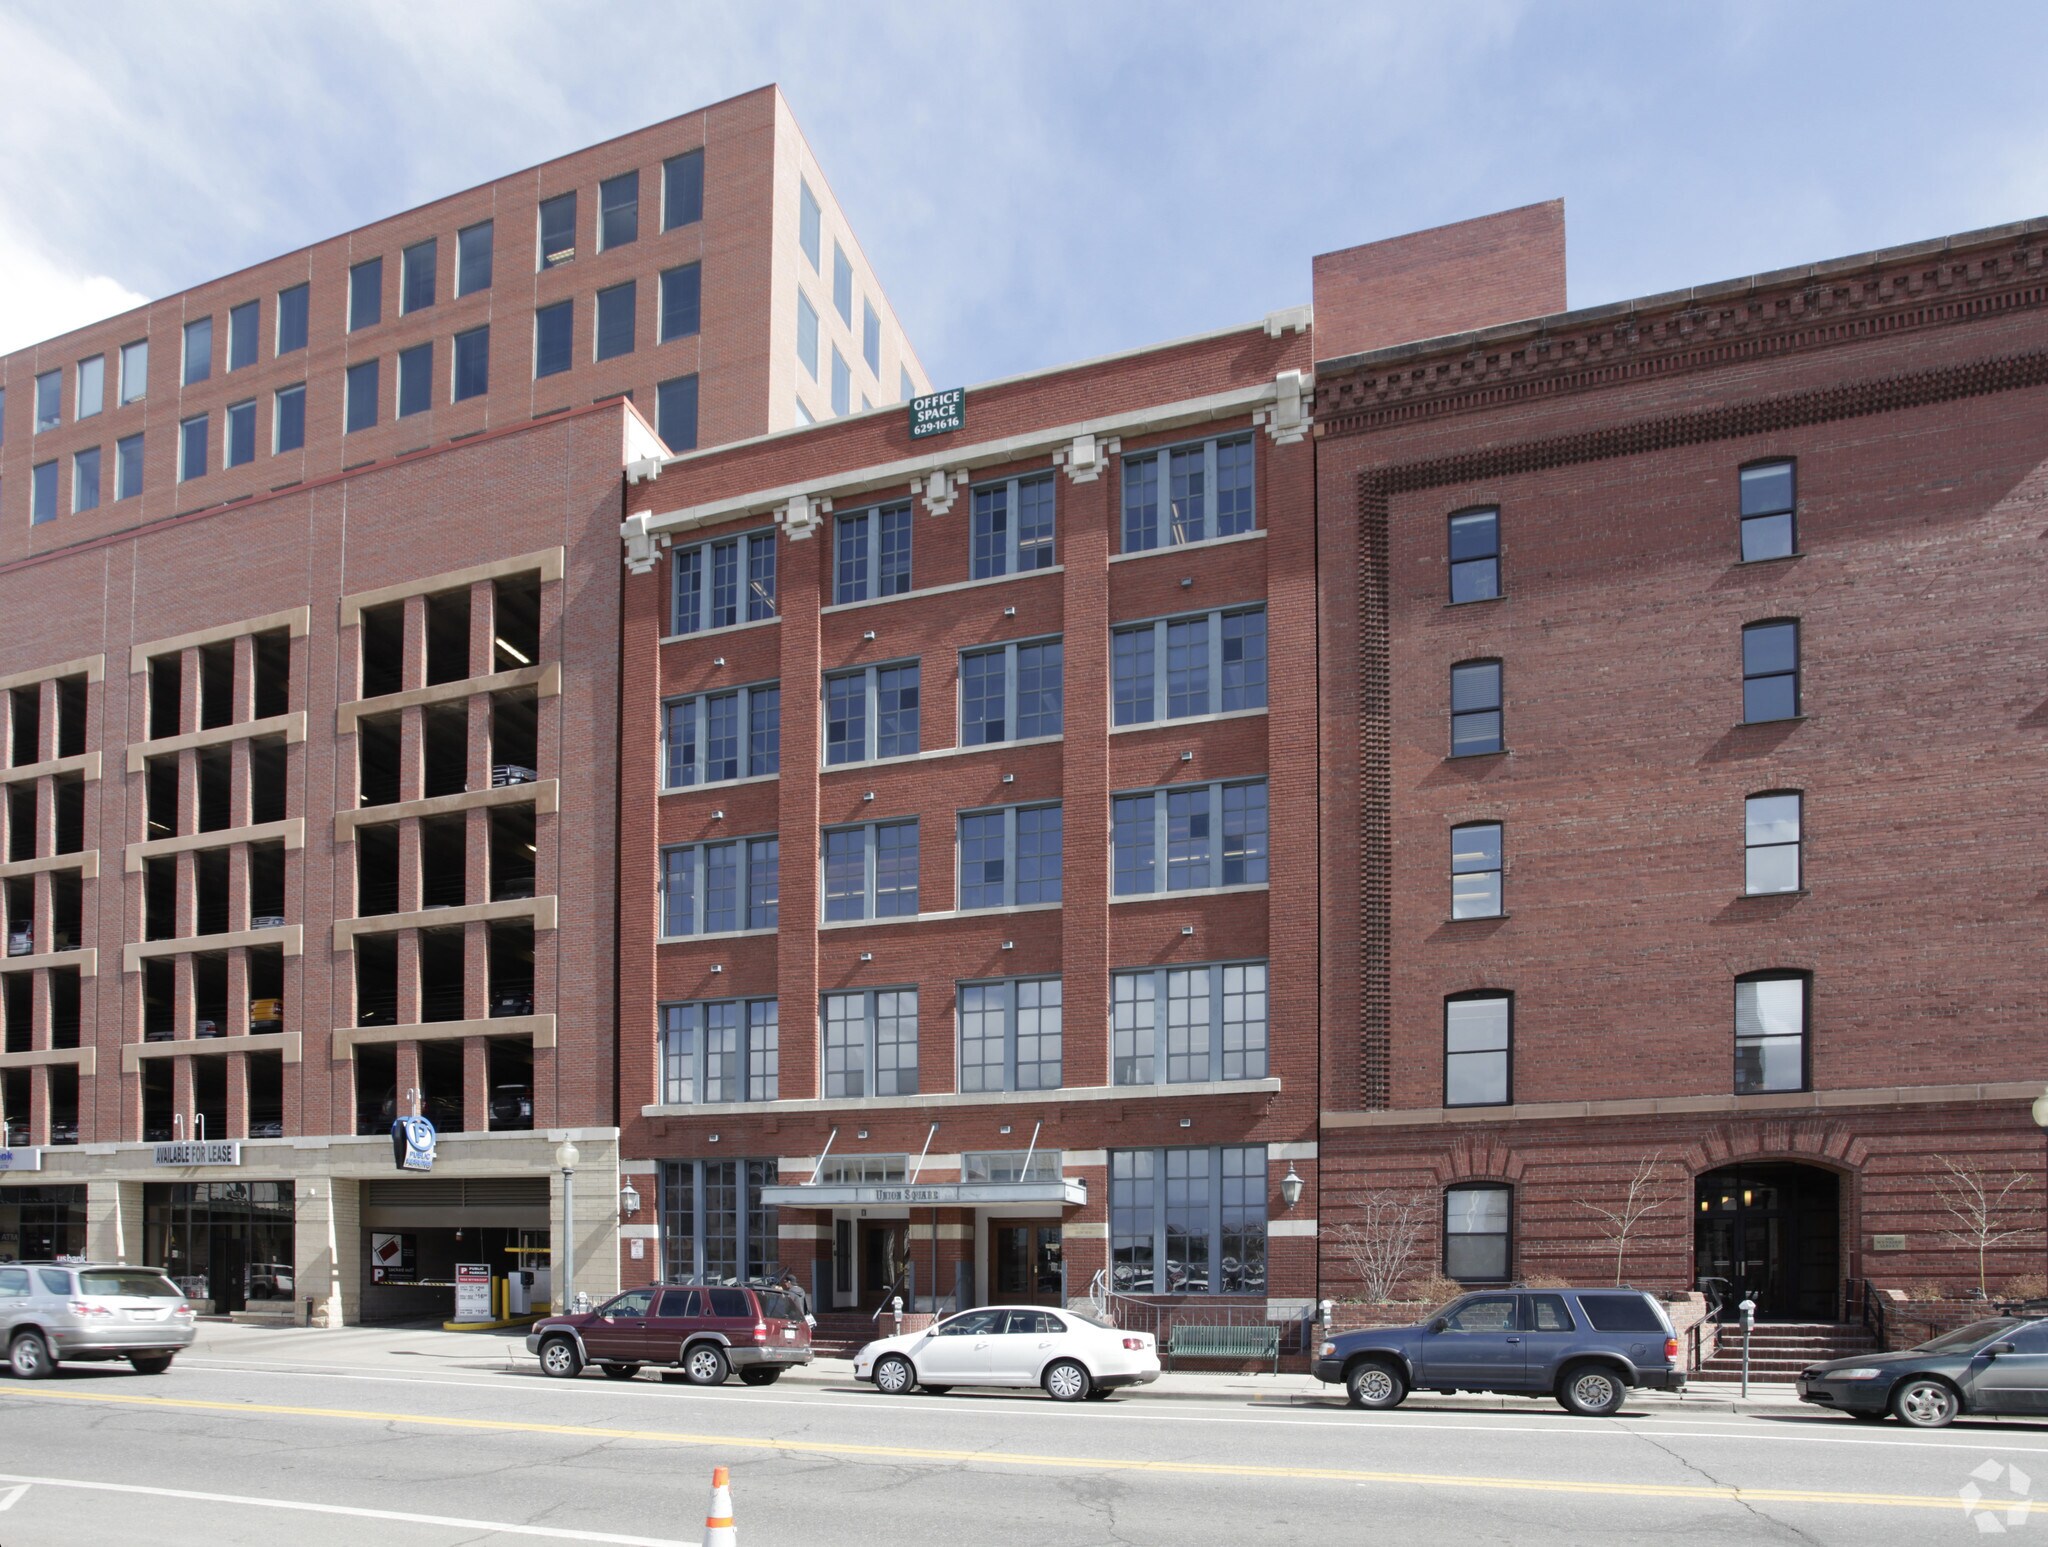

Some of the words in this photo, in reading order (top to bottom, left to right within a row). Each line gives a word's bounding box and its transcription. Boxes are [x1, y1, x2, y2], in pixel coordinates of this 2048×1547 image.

[914, 391, 960, 411] OFFICE
[917, 404, 956, 422] SPACE
[156, 1146, 190, 1164] AVAILABLE
[191, 1146, 206, 1163] FOR
[208, 1145, 232, 1163] LEASE
[409, 1151, 431, 1160] PUBLIC
[1, 1233, 18, 1241] ATM
[56, 1254, 87, 1263] usbank
[374, 1268, 384, 1282] P
